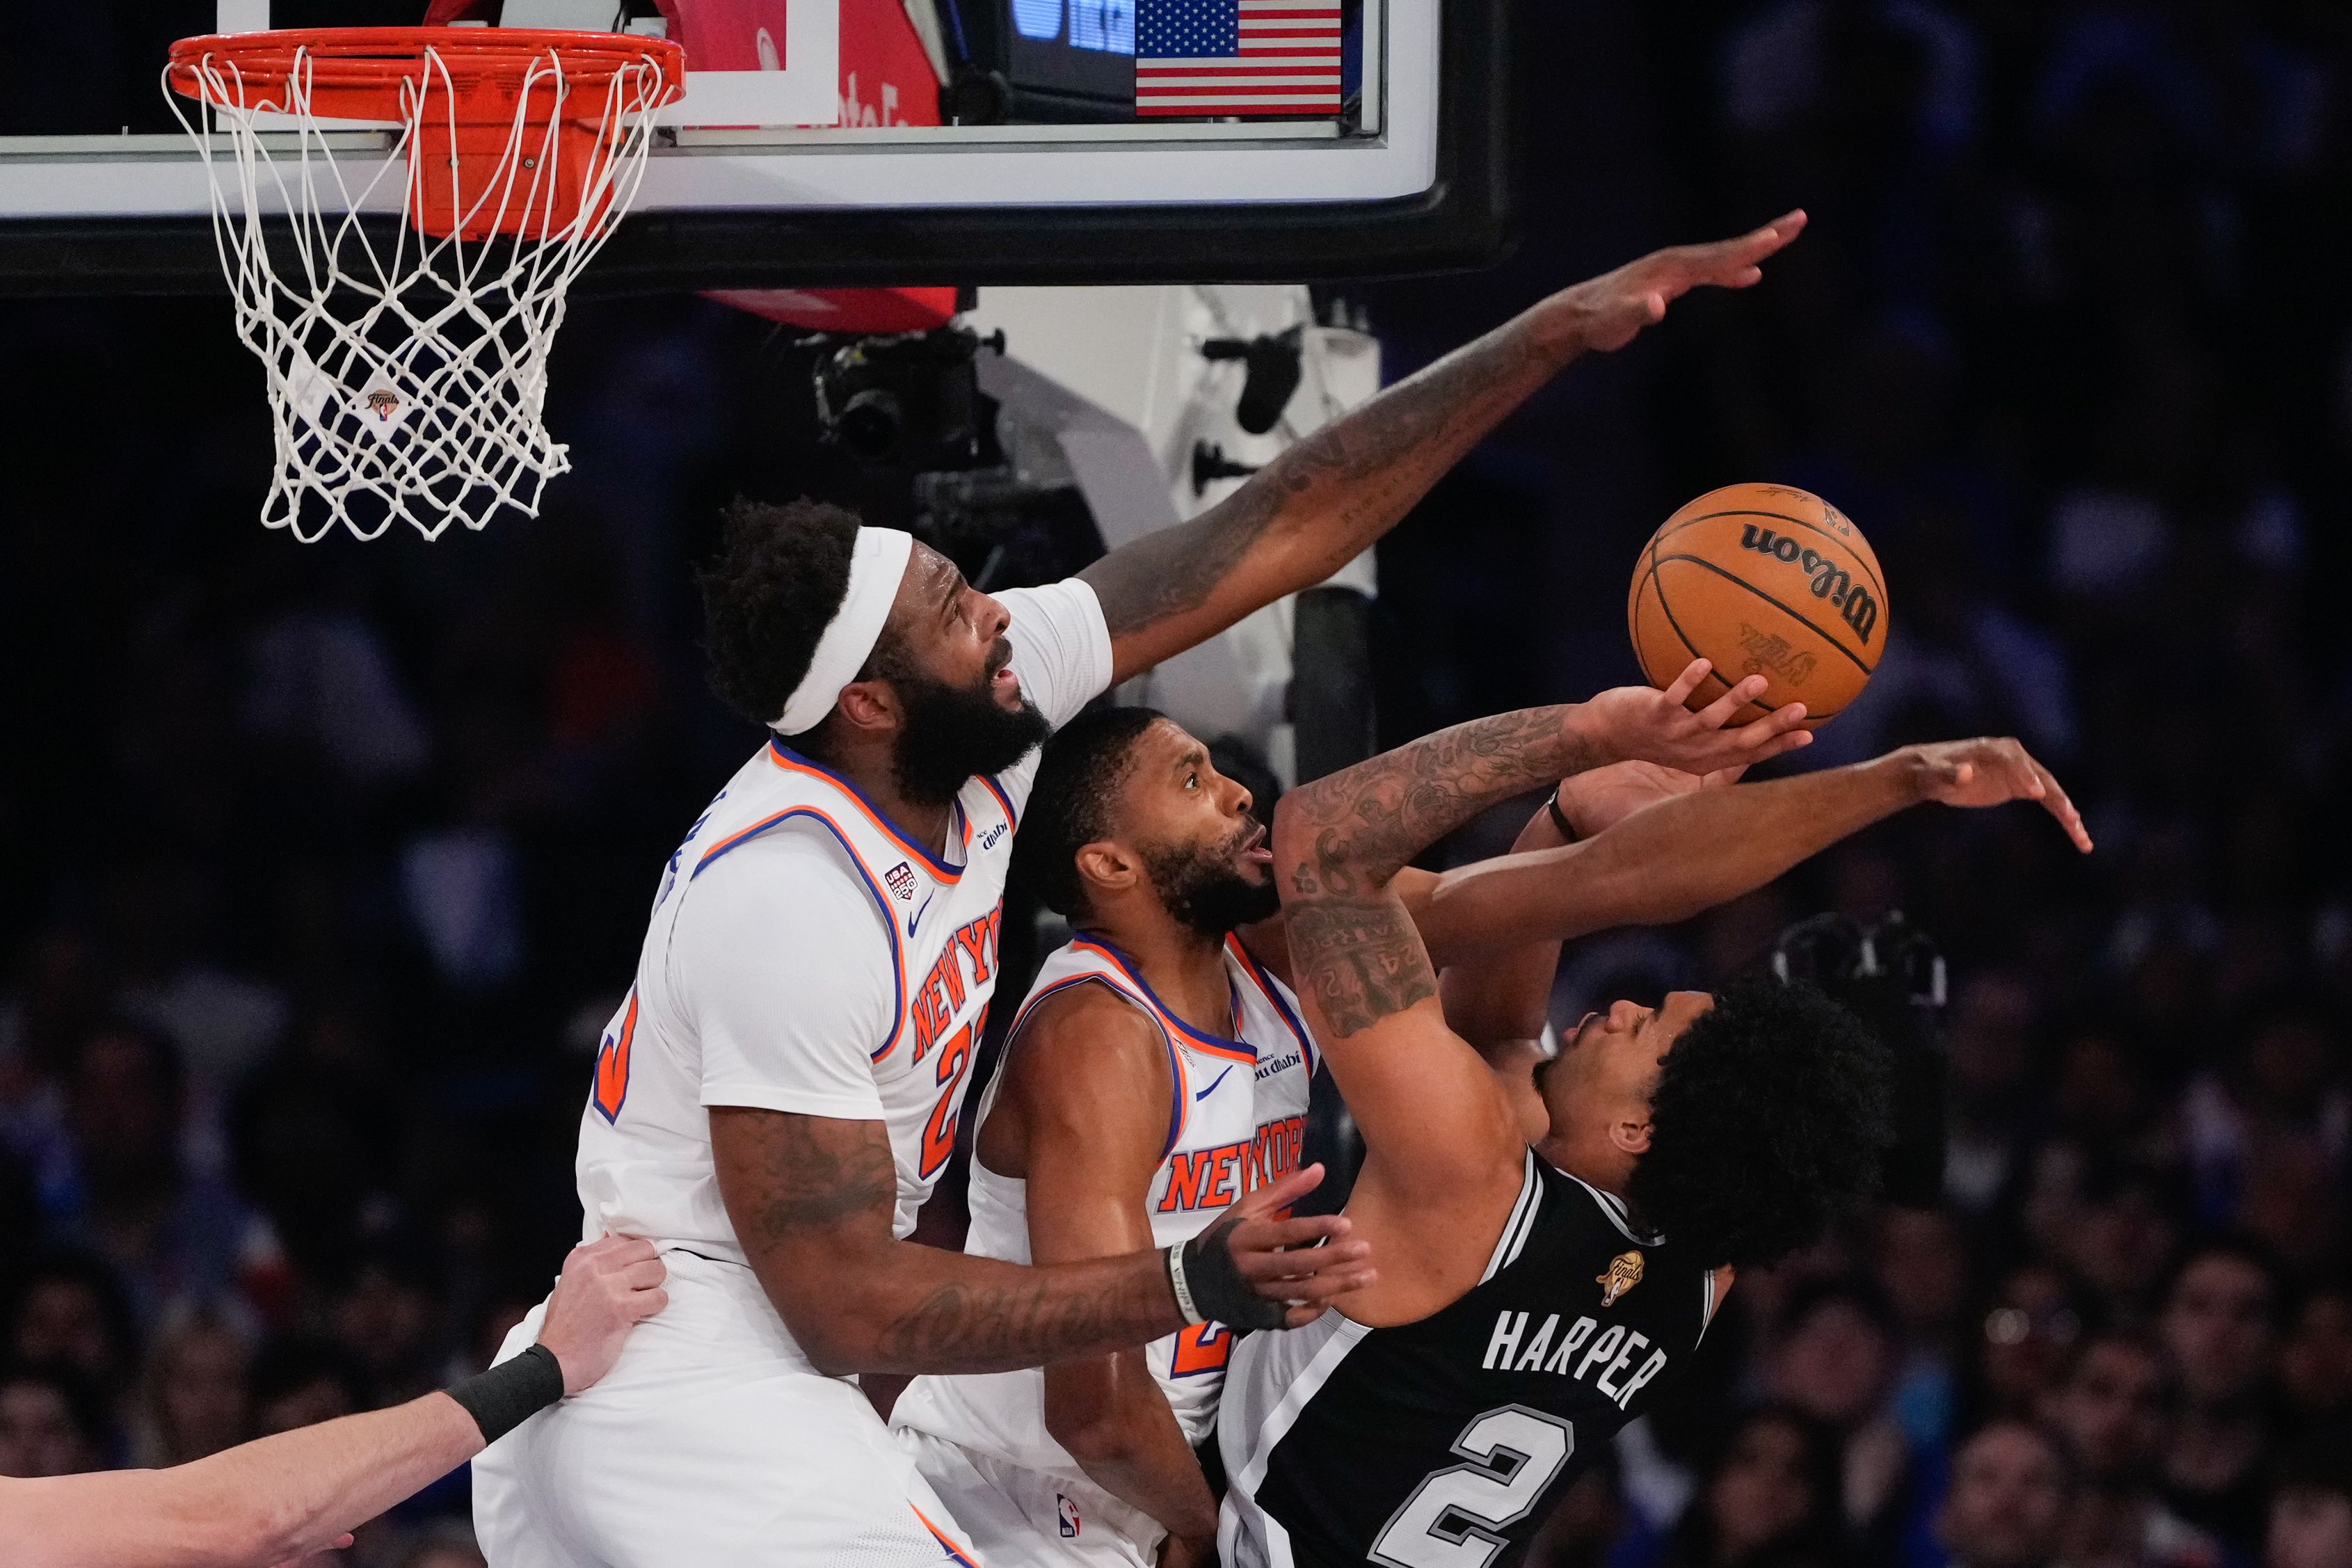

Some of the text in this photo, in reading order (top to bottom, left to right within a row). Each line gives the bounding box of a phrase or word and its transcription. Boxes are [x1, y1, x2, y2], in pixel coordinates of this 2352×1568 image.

[1739, 523, 1878, 647] Wilson
[886, 866, 909, 883] USA
[893, 878, 918, 900] 250
[911, 932, 968, 1070] NEW
[918, 998, 991, 1181] 2
[1270, 1050, 1301, 1073] dhabi
[1254, 1114, 1308, 1189] YOR
[1482, 1310, 1667, 1411] HARPER
[1366, 1402, 1575, 1568] 2
